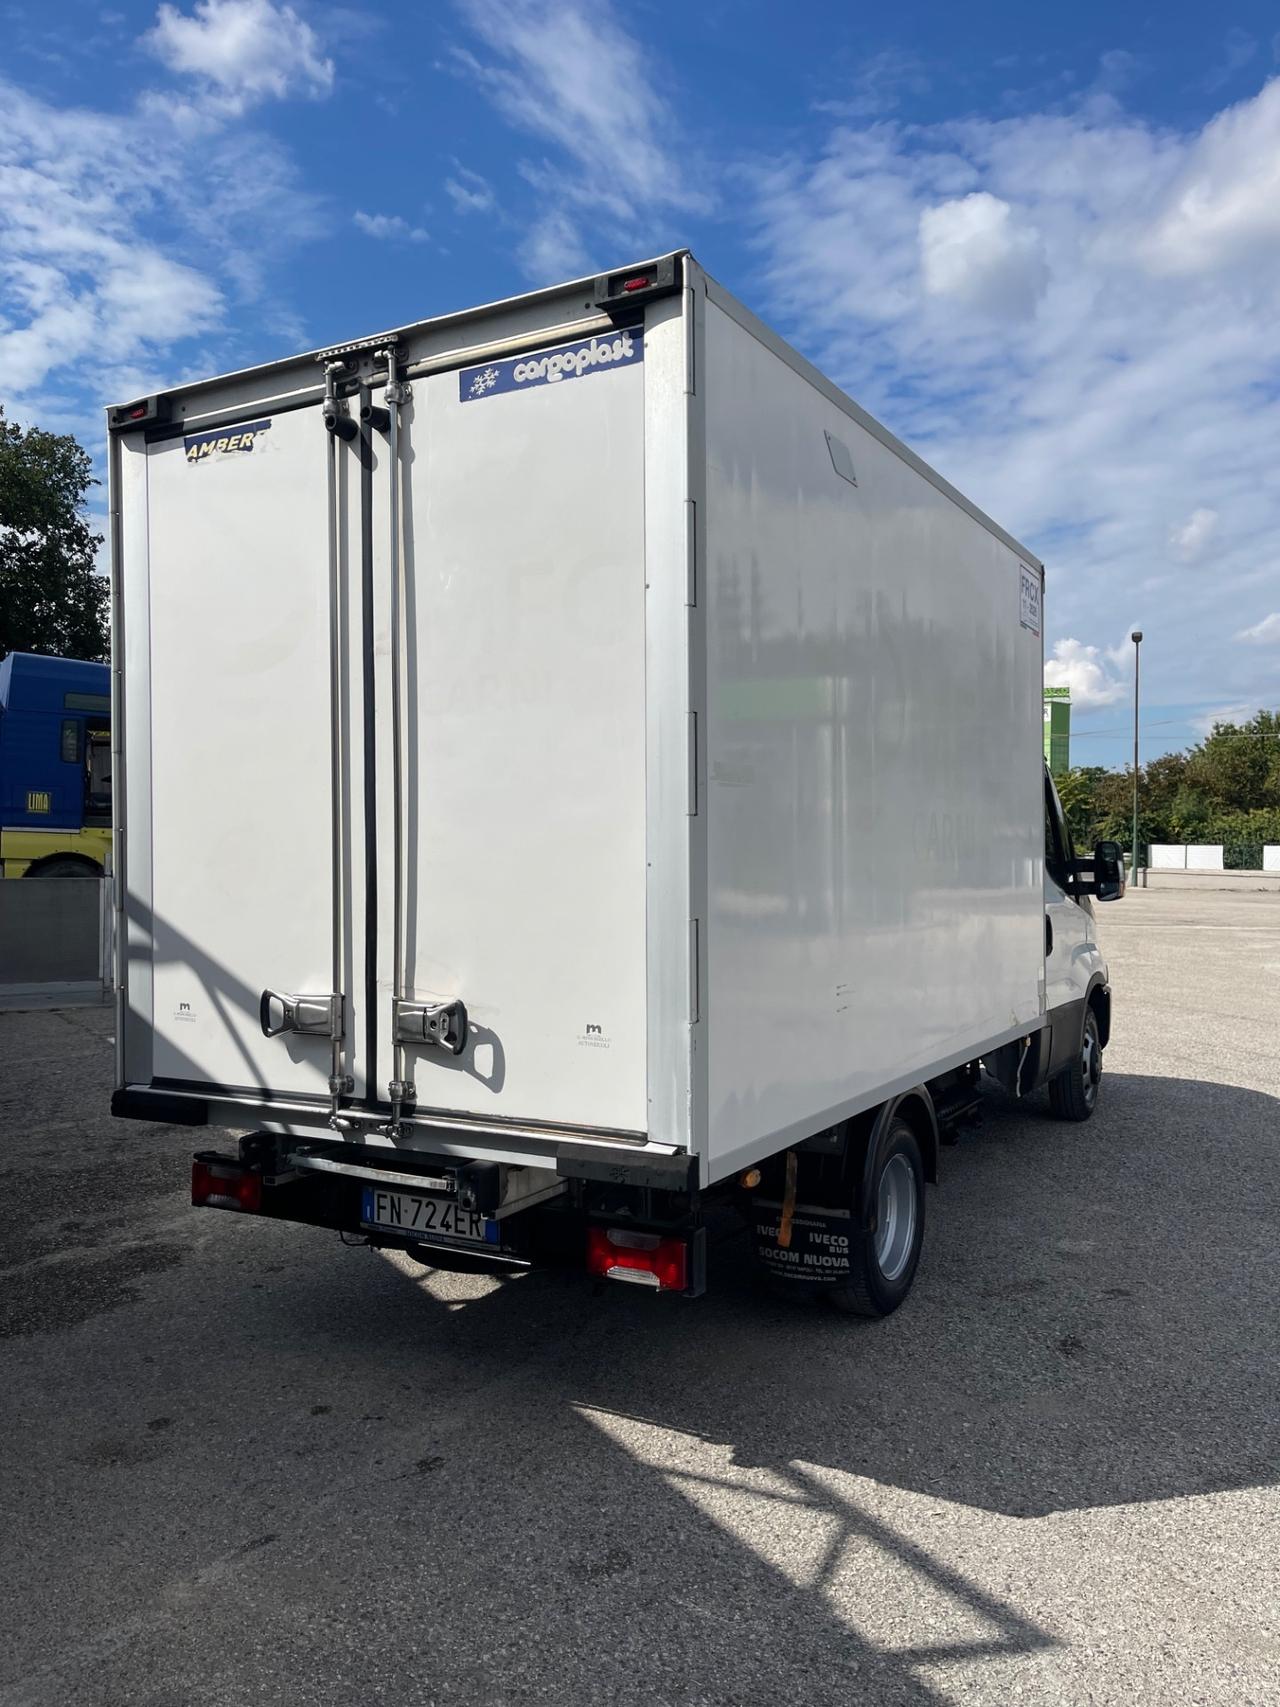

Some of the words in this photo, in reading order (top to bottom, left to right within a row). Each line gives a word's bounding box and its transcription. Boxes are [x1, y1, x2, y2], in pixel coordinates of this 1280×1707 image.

[513, 331, 634, 383] cargoplast
[28, 792, 49, 811] LIMA
[809, 1231, 849, 1247] IVECO
[759, 1246, 800, 1263] SOCOM
[803, 1253, 850, 1268] NUOVA
[828, 1246, 849, 1255] BUS
